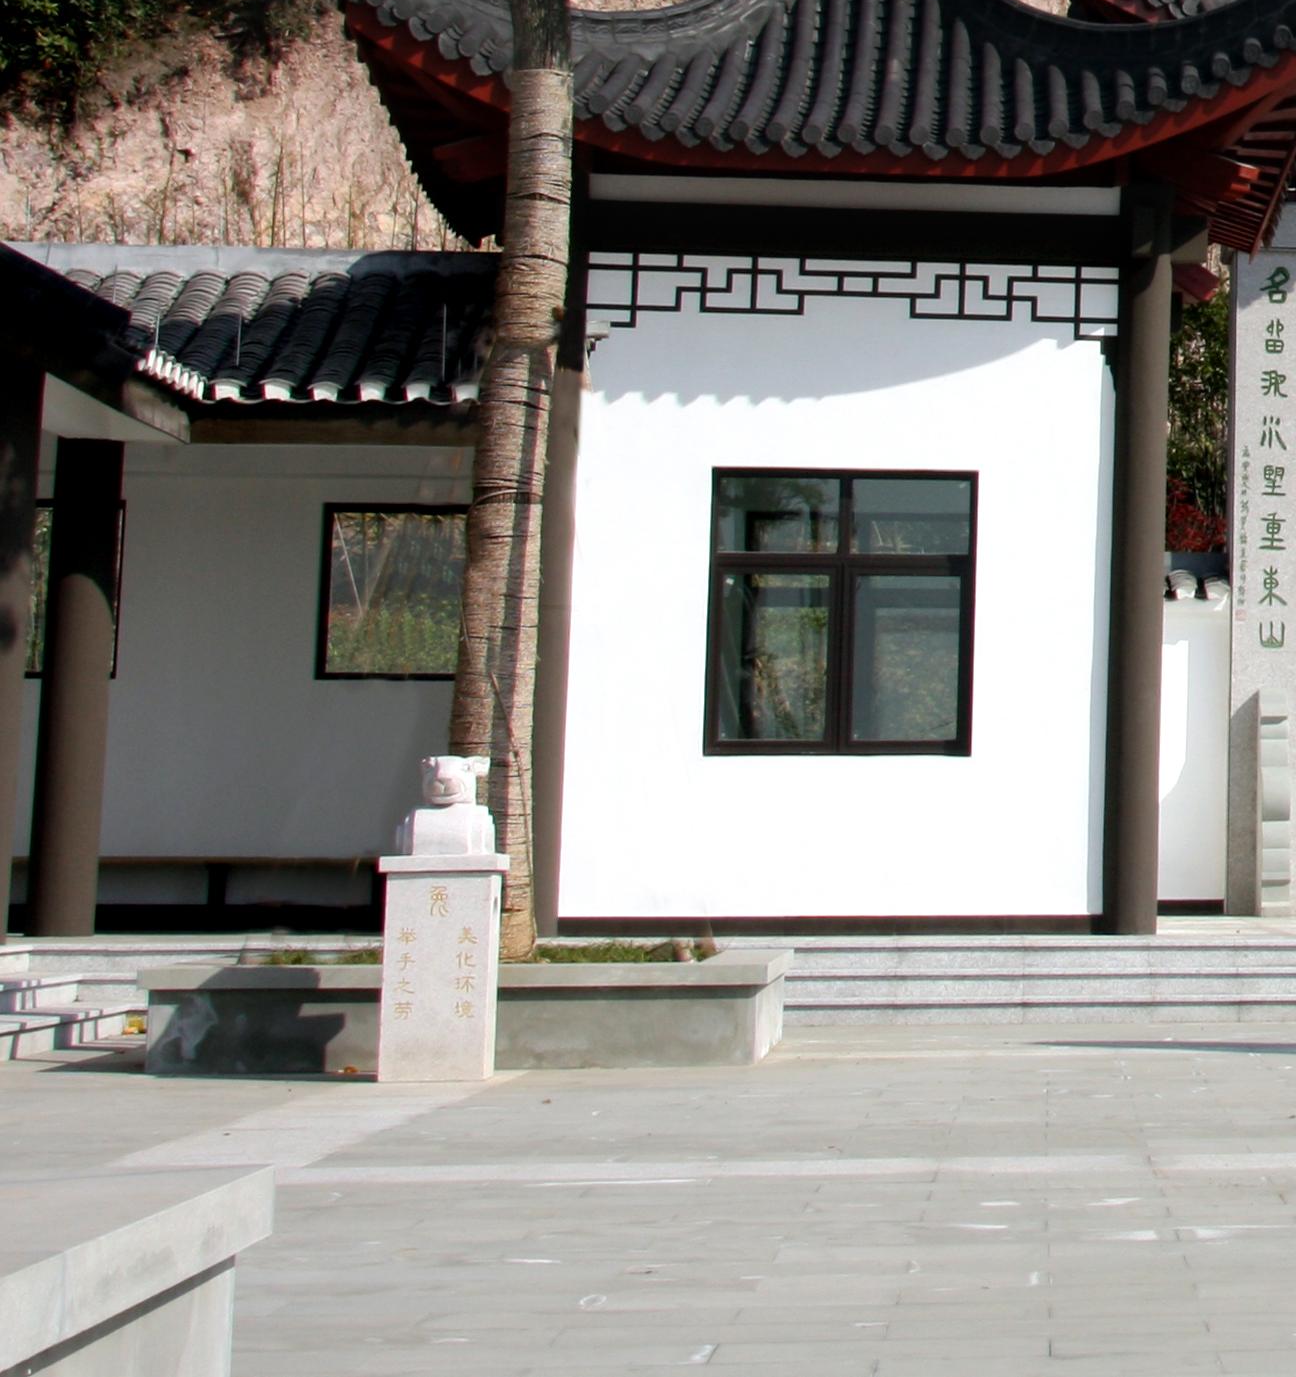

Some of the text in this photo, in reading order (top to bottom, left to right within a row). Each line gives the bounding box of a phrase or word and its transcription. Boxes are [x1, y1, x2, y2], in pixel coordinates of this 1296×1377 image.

[393, 926, 417, 1021] 举手之劳
[454, 926, 478, 1019] 美化环境
